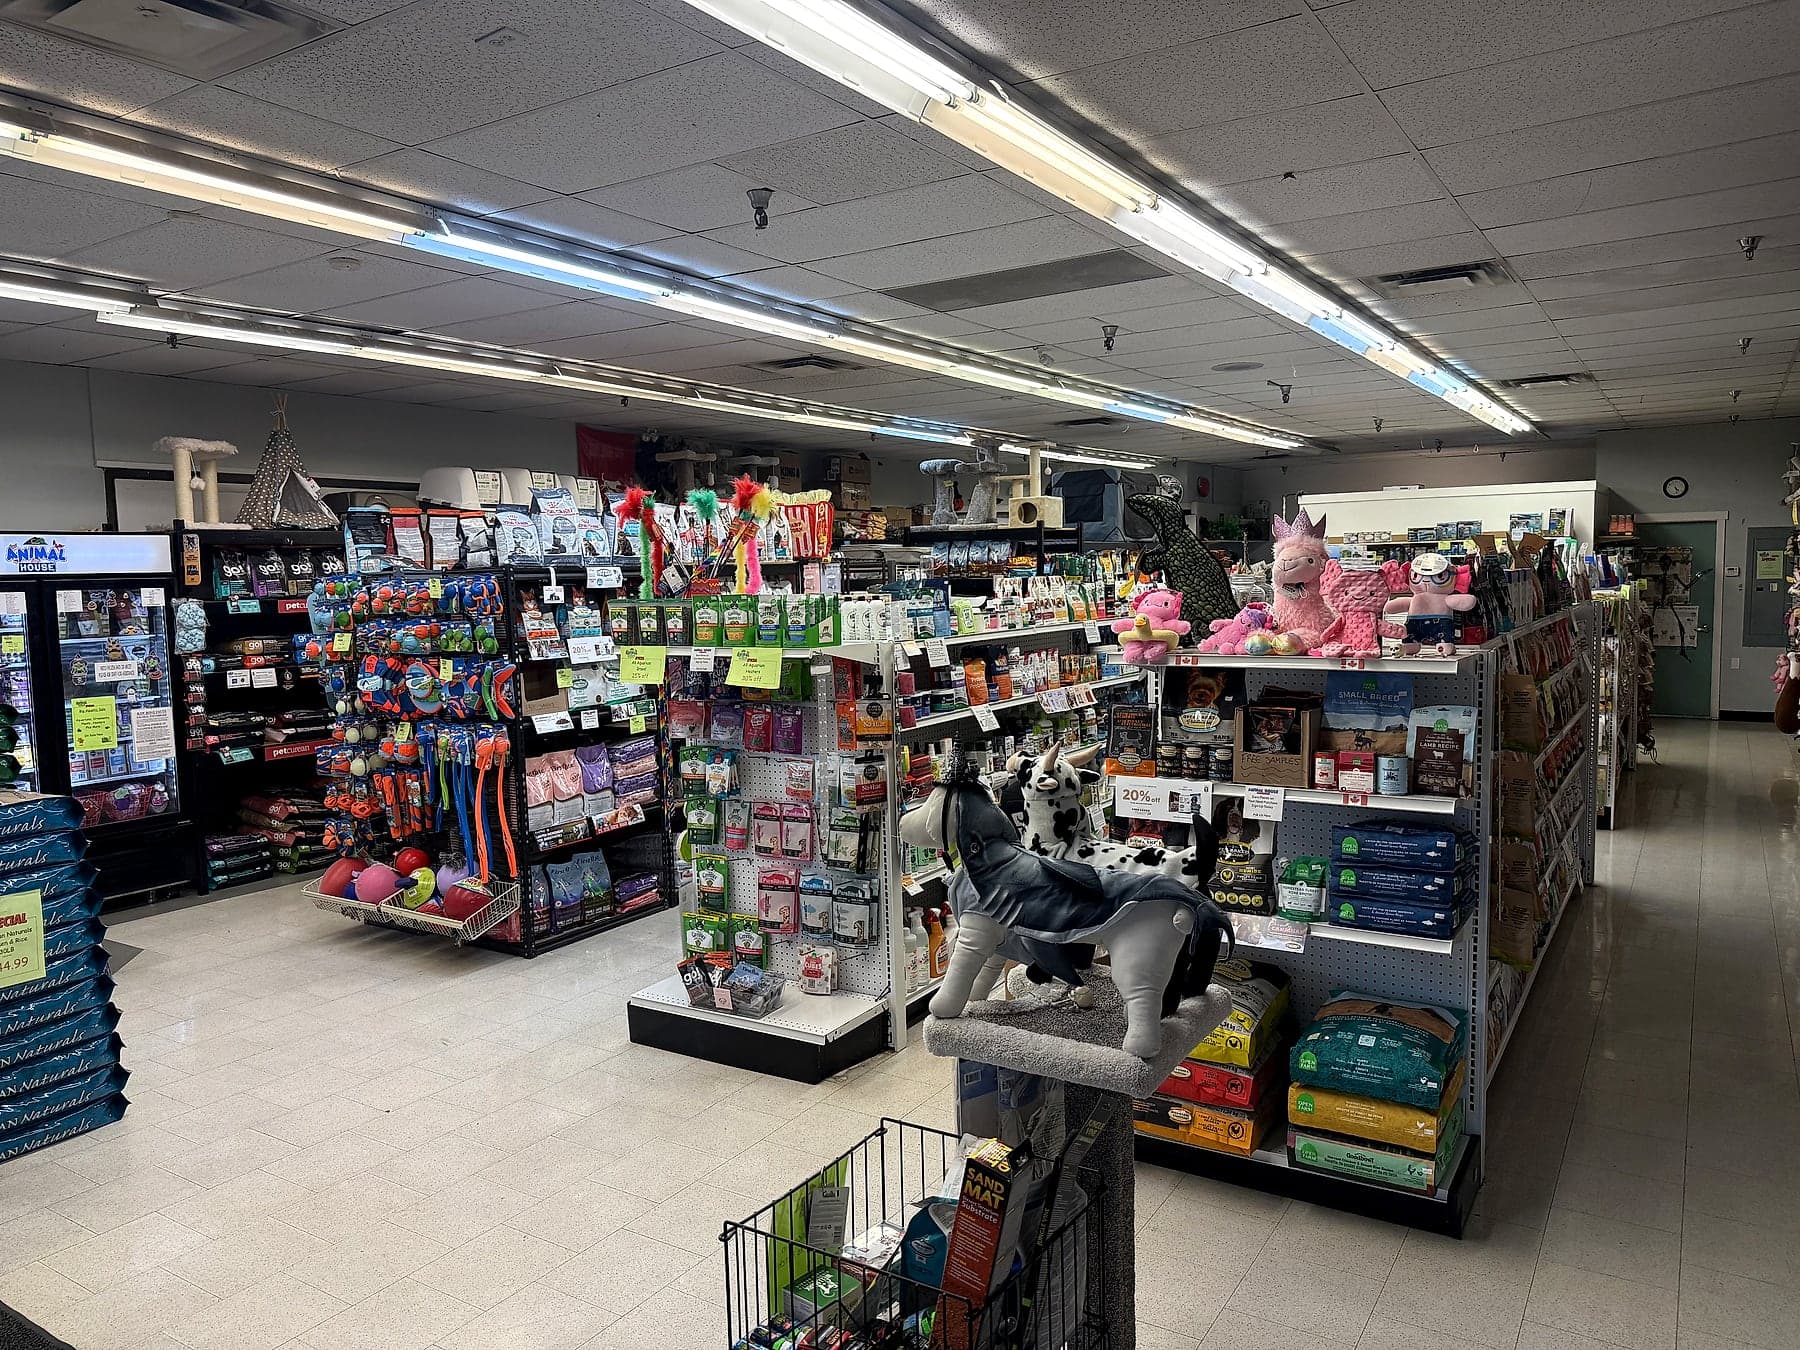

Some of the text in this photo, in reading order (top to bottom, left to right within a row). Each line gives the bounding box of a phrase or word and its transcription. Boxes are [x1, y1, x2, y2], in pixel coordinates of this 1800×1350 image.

[6, 546, 66, 561] ANIMAL
[20, 563, 55, 572] HOUSE
[1339, 691, 1400, 702] SMALL BREED
[272, 745, 310, 758] petcurean
[1241, 753, 1301, 766] FREE SAMPLES
[1122, 788, 1151, 803] 20%
[7, 927, 33, 938] Naturals
[1, 970, 74, 1001] Naturals
[5, 1001, 78, 1035] Naturals
[14, 1029, 86, 1064] Naturals
[20, 1058, 92, 1093] Naturals
[21, 1090, 94, 1125] Naturals
[1298, 1105, 1313, 1113] FARM
[21, 1118, 94, 1154] Naturals
[1302, 1154, 1317, 1162] FARM
[967, 1167, 1005, 1194] SAND
[963, 1180, 1005, 1209] MAT
[961, 1200, 998, 1224] Substrate
